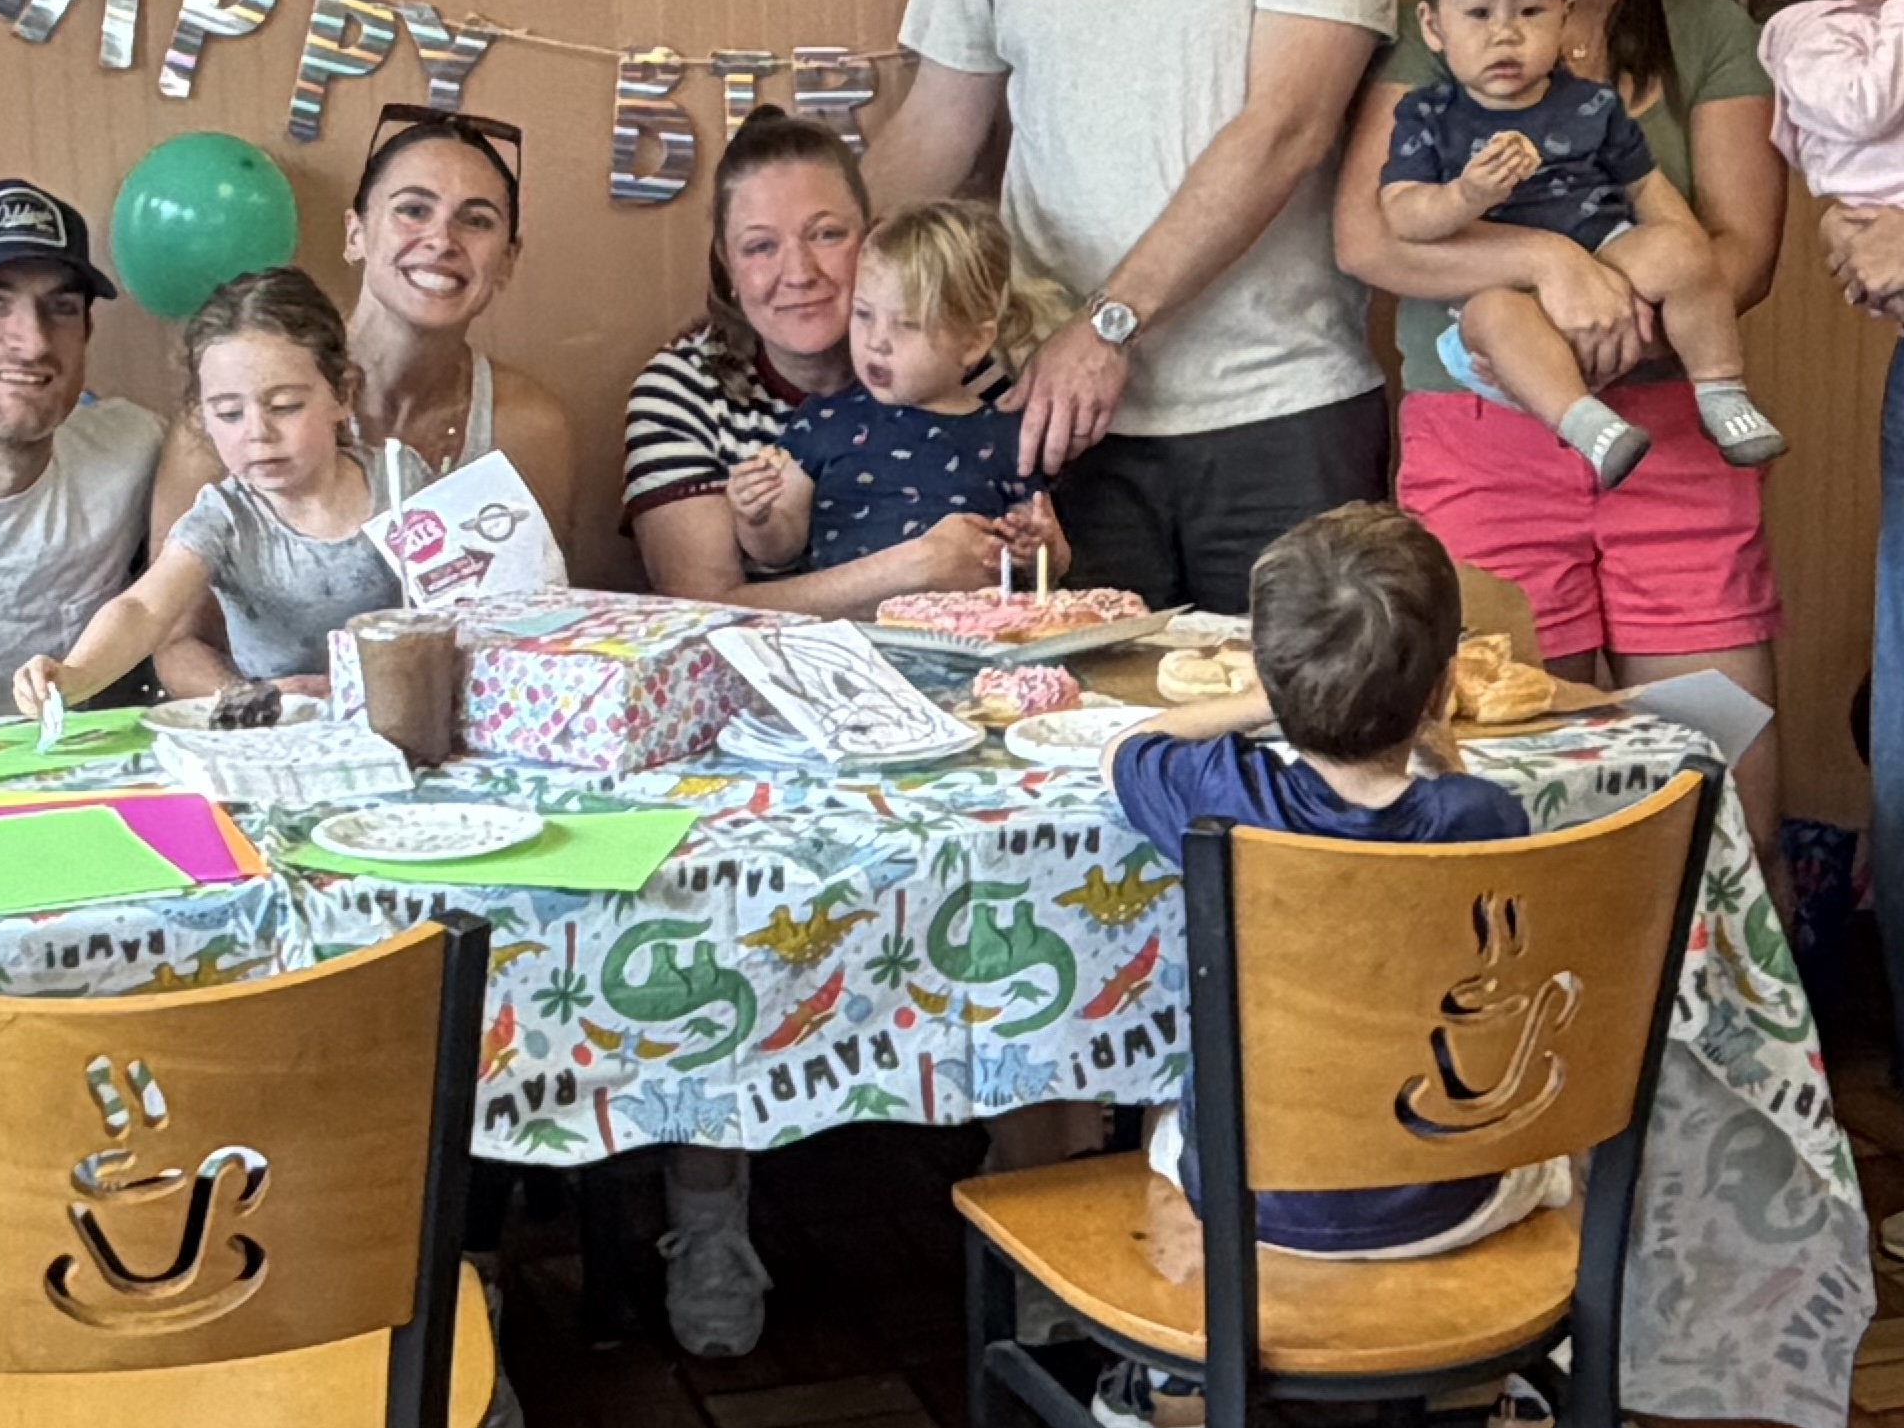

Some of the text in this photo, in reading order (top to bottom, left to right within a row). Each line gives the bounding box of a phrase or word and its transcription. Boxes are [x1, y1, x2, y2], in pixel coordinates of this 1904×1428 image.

[998, 824, 1101, 859] RAWR!
[677, 860, 785, 897] RAWR!
[45, 928, 165, 969] RAWR!
[1070, 1004, 1191, 1090] AWR!
[748, 1030, 899, 1124] RAWR!
